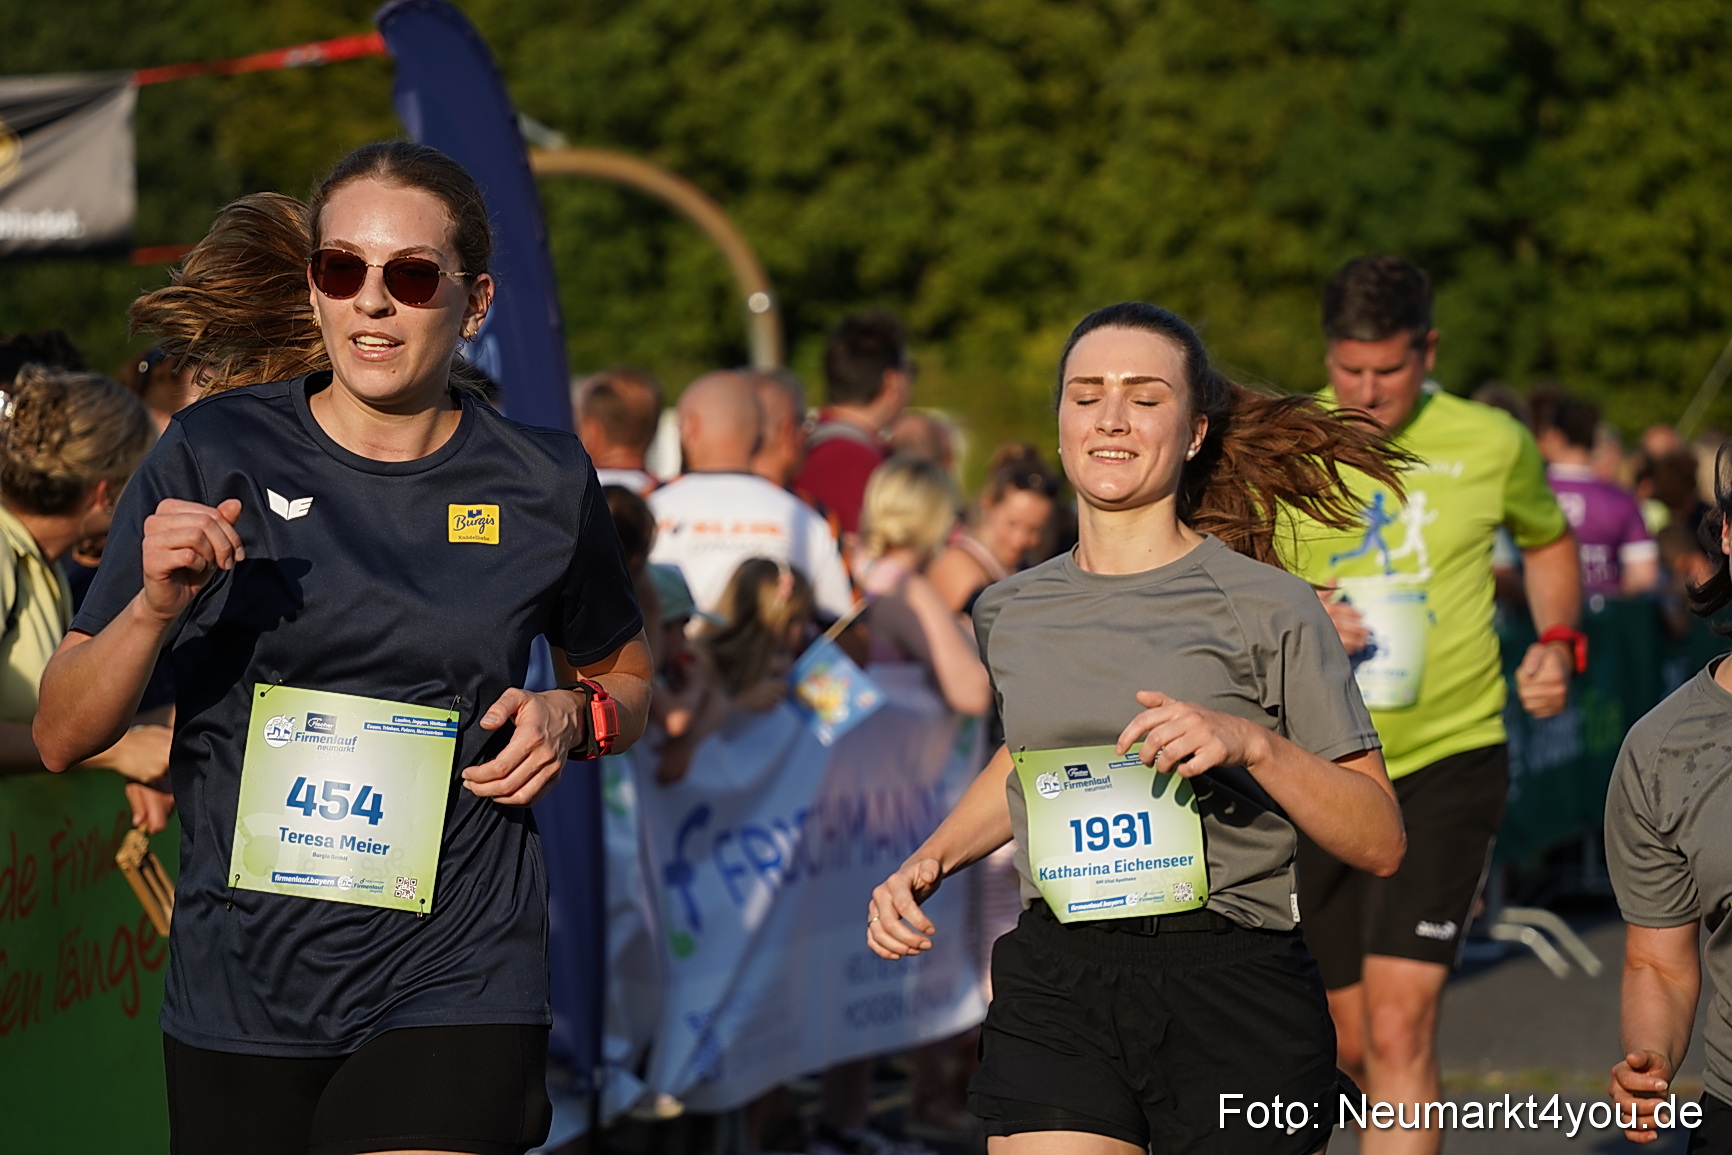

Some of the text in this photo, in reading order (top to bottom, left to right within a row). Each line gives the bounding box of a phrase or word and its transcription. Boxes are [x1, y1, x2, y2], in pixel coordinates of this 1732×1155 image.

[453, 513, 495, 534] Burgis
[294, 732, 358, 746] Firmenlauf
[317, 744, 355, 753] neumarkt
[1063, 775, 1111, 790] Firmenlauf
[1084, 783, 1113, 793] neumarkt
[286, 776, 384, 826] 454
[1069, 811, 1153, 853] 1931
[279, 826, 390, 856] Teresa Meier
[1039, 855, 1194, 882] Katharina Eichenseer
[274, 873, 335, 887] firmenlauf.bayern
[1070, 898, 1125, 912] firmenlauf.bayern
